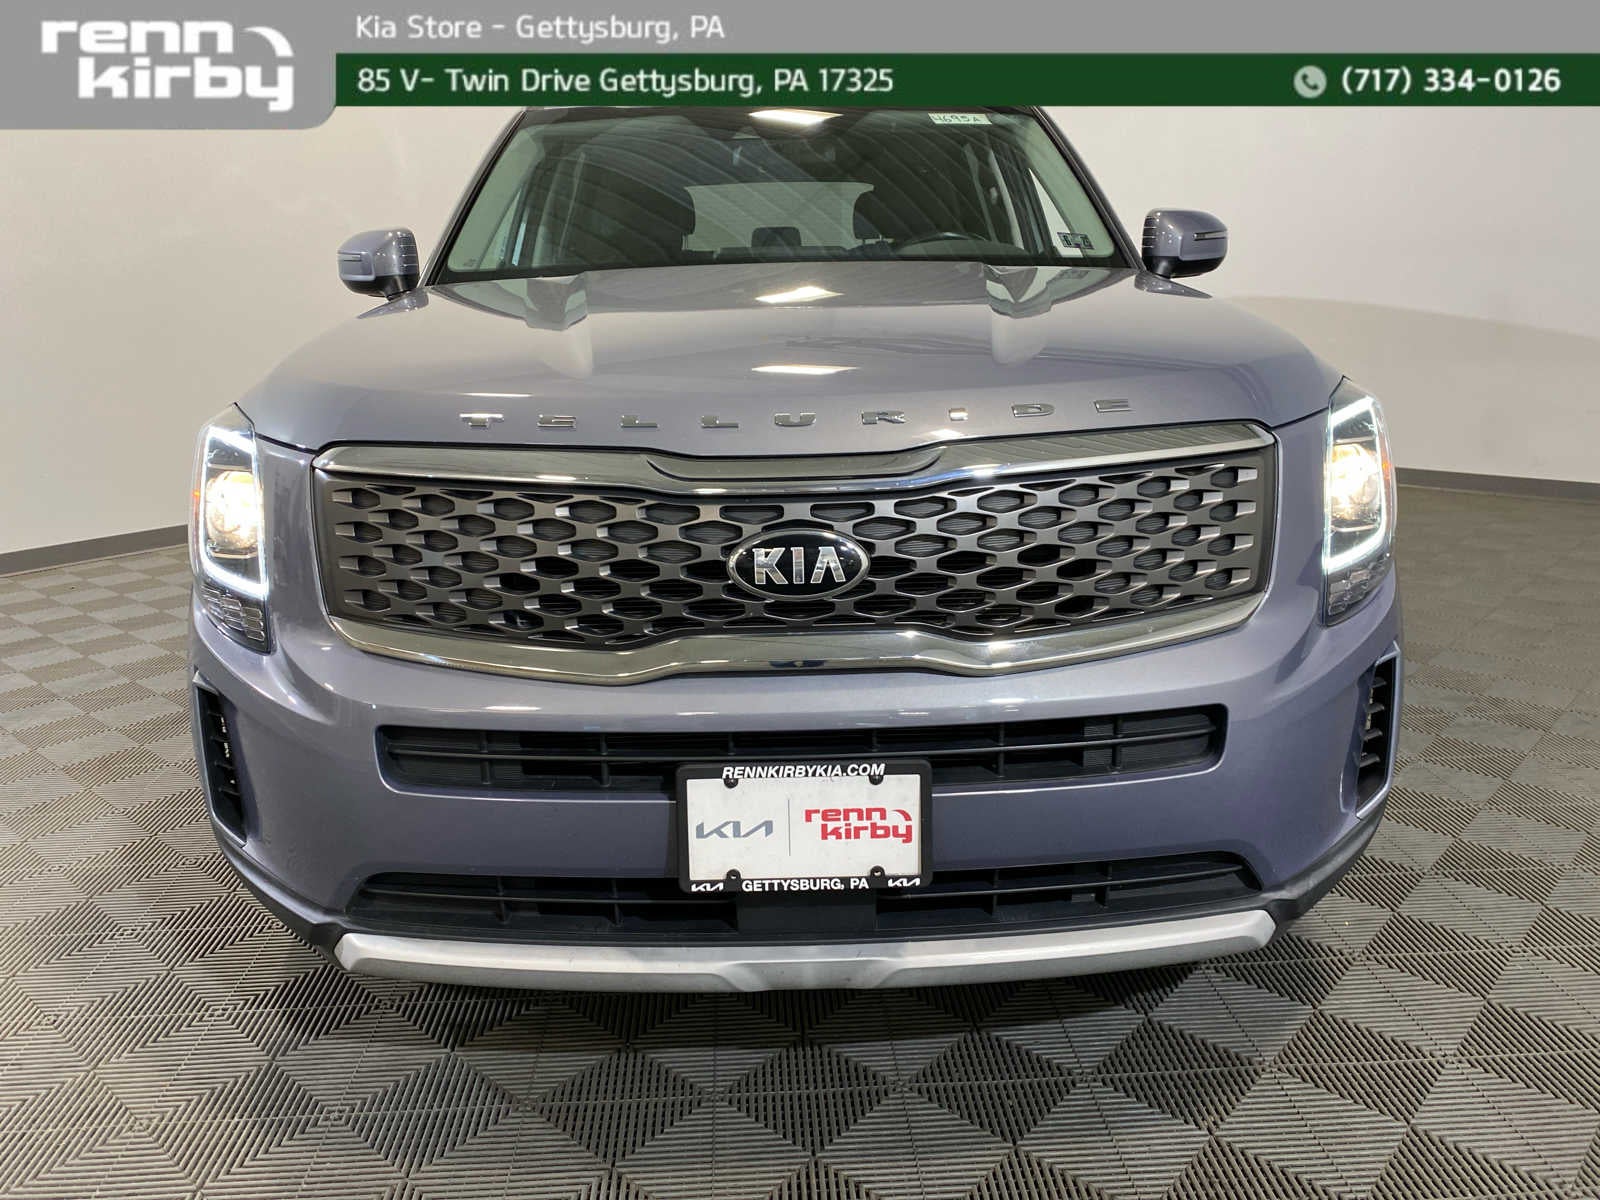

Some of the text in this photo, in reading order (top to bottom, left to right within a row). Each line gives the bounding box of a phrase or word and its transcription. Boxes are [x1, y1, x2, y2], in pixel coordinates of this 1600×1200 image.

[459, 398, 1133, 430] TELLURIDE
[752, 548, 846, 585] KIA
[722, 763, 886, 779] RENNKIRBYKIA.COM
[804, 807, 887, 823] renn
[820, 822, 913, 844] kirby
[741, 878, 869, 892] GETTYSBURG, PA
